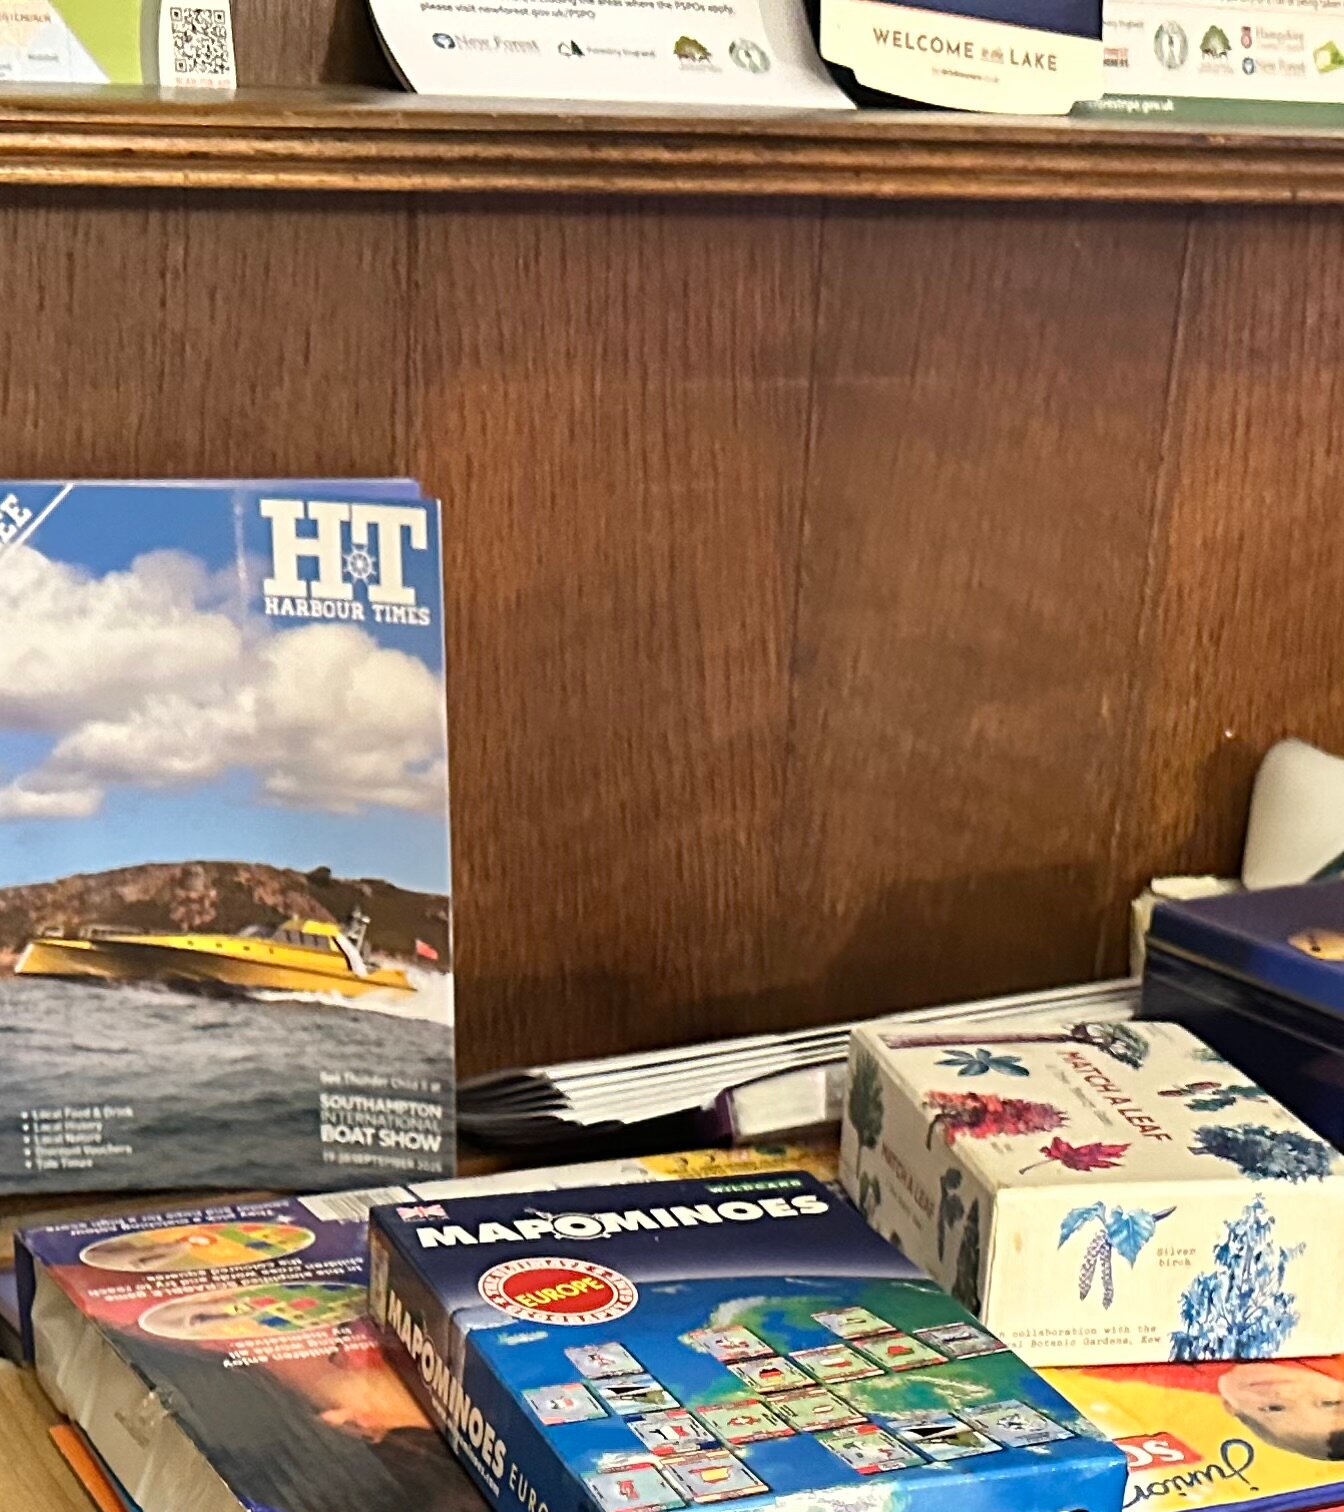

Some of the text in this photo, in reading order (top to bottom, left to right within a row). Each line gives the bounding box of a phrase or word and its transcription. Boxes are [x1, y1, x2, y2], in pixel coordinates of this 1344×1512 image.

[872, 27, 975, 59] WELCOME
[1010, 48, 1058, 72] LAKE
[264, 596, 431, 626] HARBOUR TIMES
[1057, 1051, 1122, 1093] MATCH
[319, 1093, 442, 1120] SOUTHAMPTON
[1103, 1095, 1132, 1106] A
[320, 1108, 439, 1132] INTERNATIONAL
[1117, 1108, 1173, 1142] LEAF
[320, 1124, 443, 1153] BOAT SHOW
[416, 1194, 830, 1248] MAPOMINOES
[1156, 1247, 1197, 1257] Silver
[1158, 1258, 1192, 1267] birch
[513, 1276, 605, 1308] EUROPE
[1012, 1324, 1157, 1338] collaboration with the
[1140, 1335, 1162, 1345] Kew
[387, 1288, 506, 1480] MAPOMINOES
